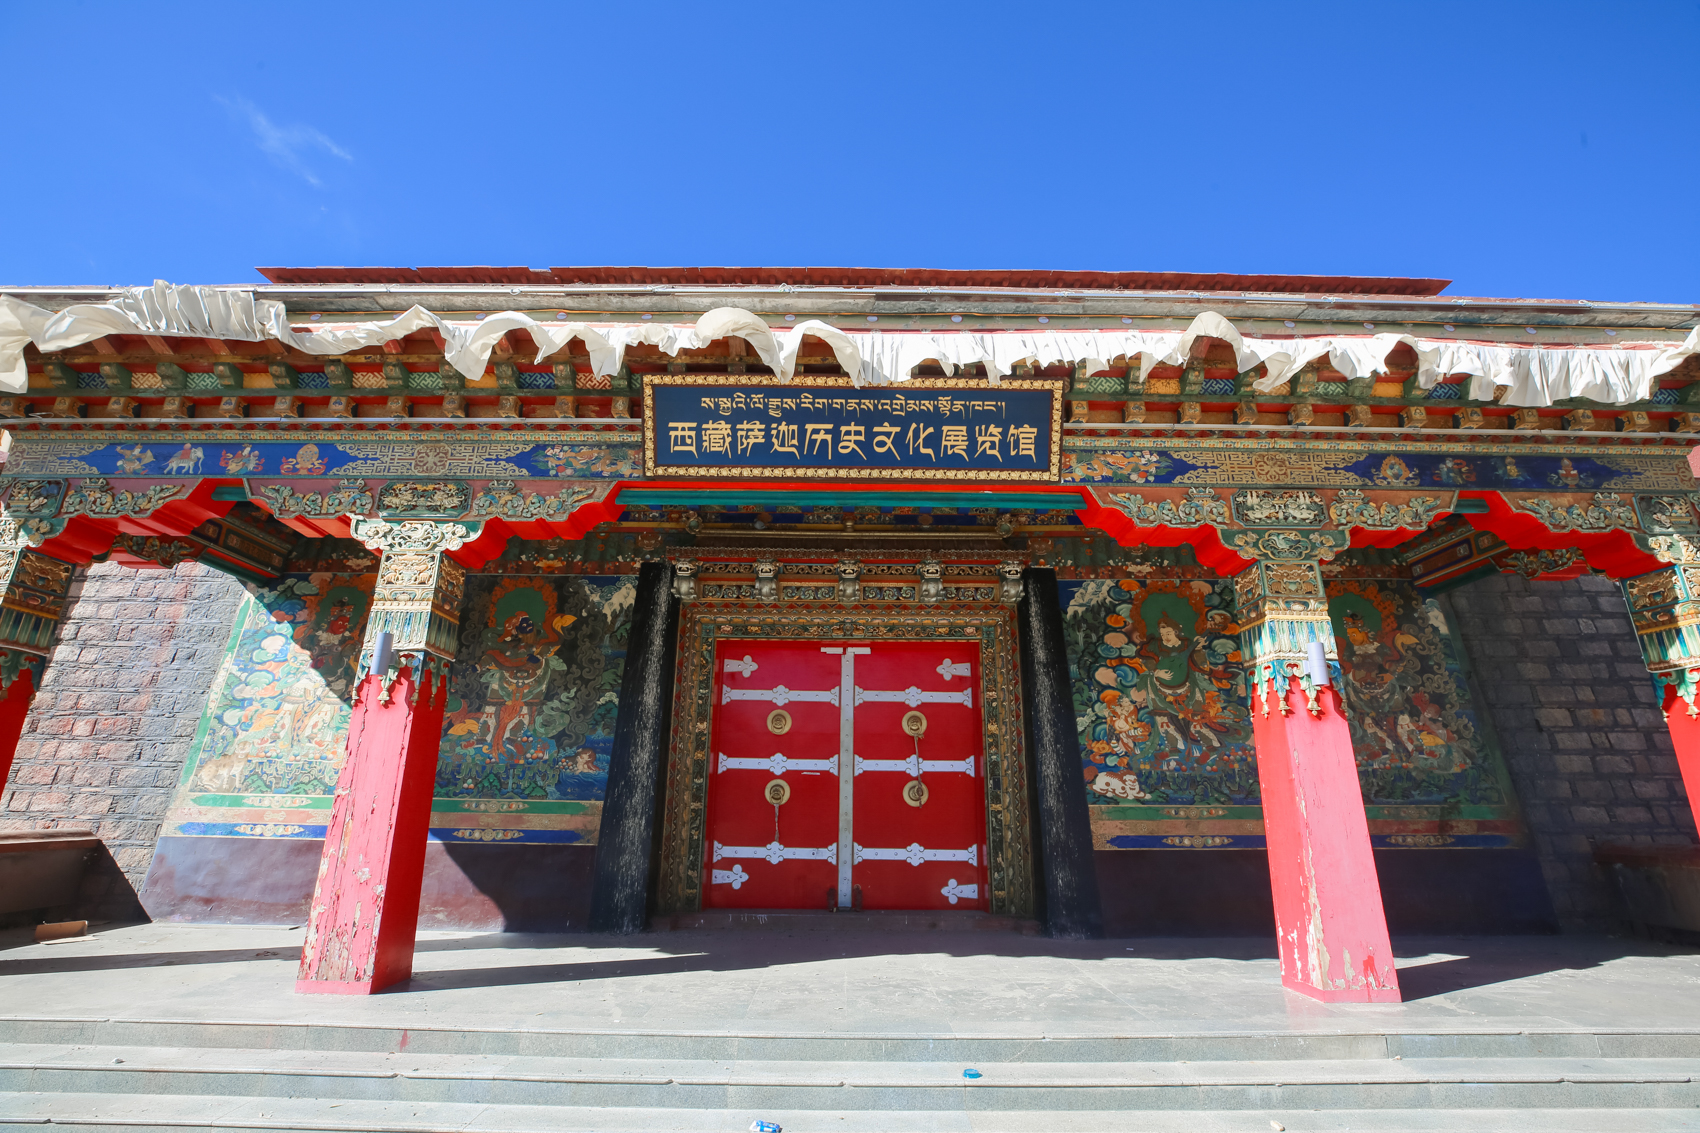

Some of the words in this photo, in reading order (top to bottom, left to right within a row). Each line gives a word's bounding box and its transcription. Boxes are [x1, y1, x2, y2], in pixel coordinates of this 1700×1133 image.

[667, 421, 1038, 463] 西藏萨迦历史文化展览馆
